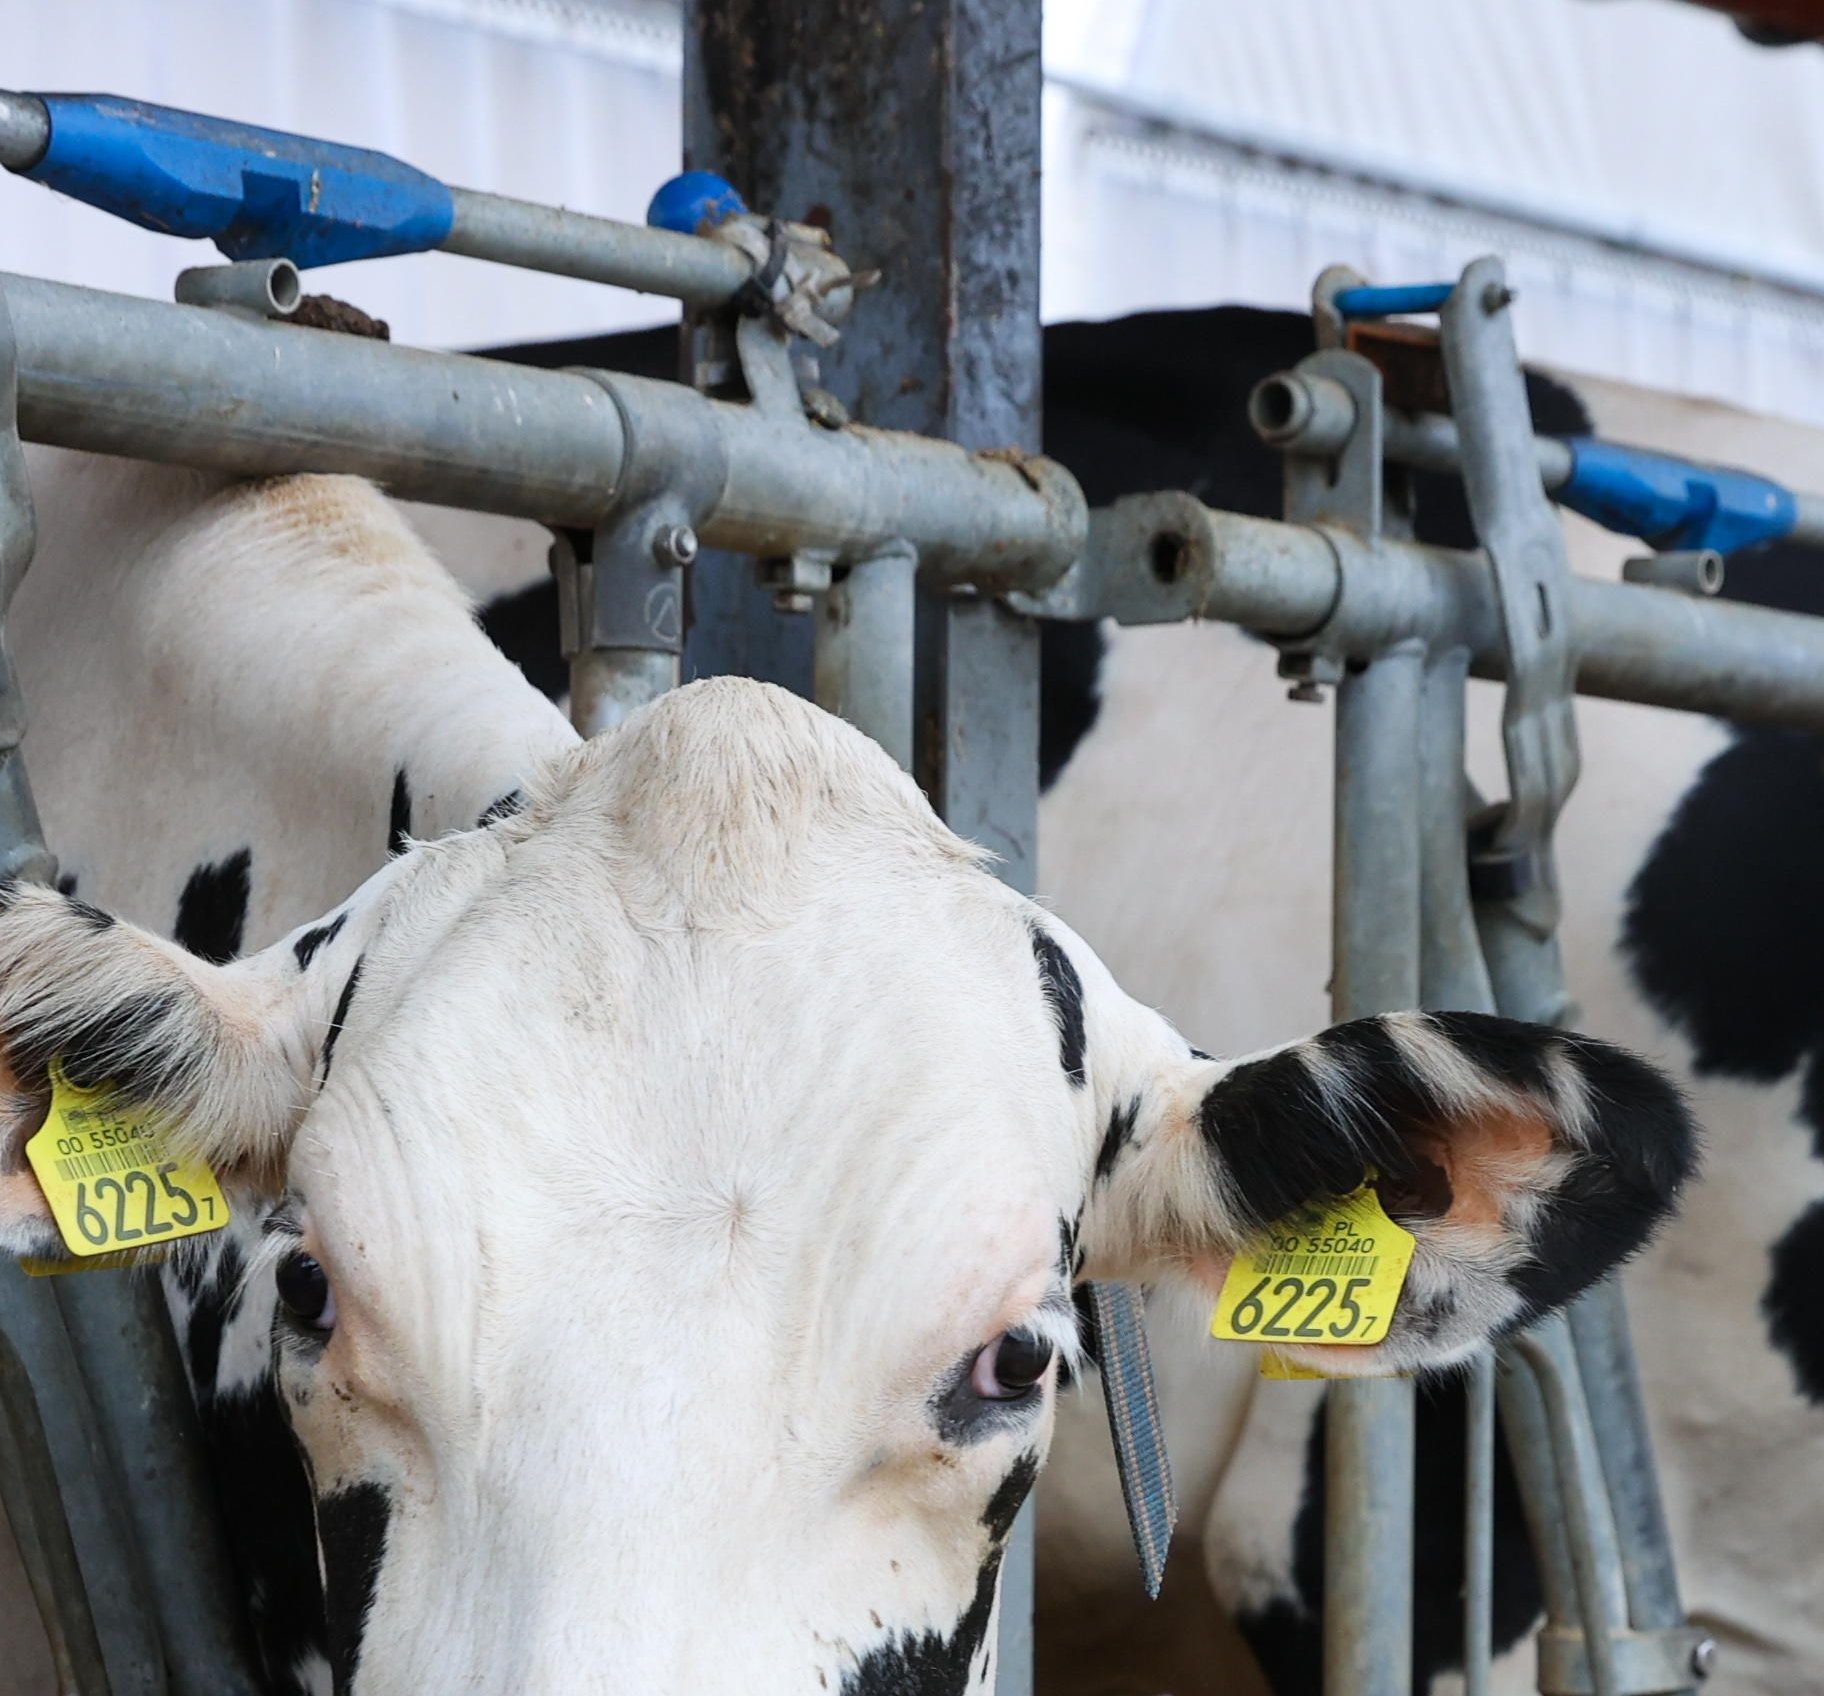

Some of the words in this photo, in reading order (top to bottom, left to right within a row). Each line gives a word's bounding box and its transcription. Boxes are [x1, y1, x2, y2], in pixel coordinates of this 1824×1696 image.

[56, 1136, 84, 1155] 00
[1334, 1221, 1358, 1236] PL
[1306, 1237, 1375, 1253] 55040
